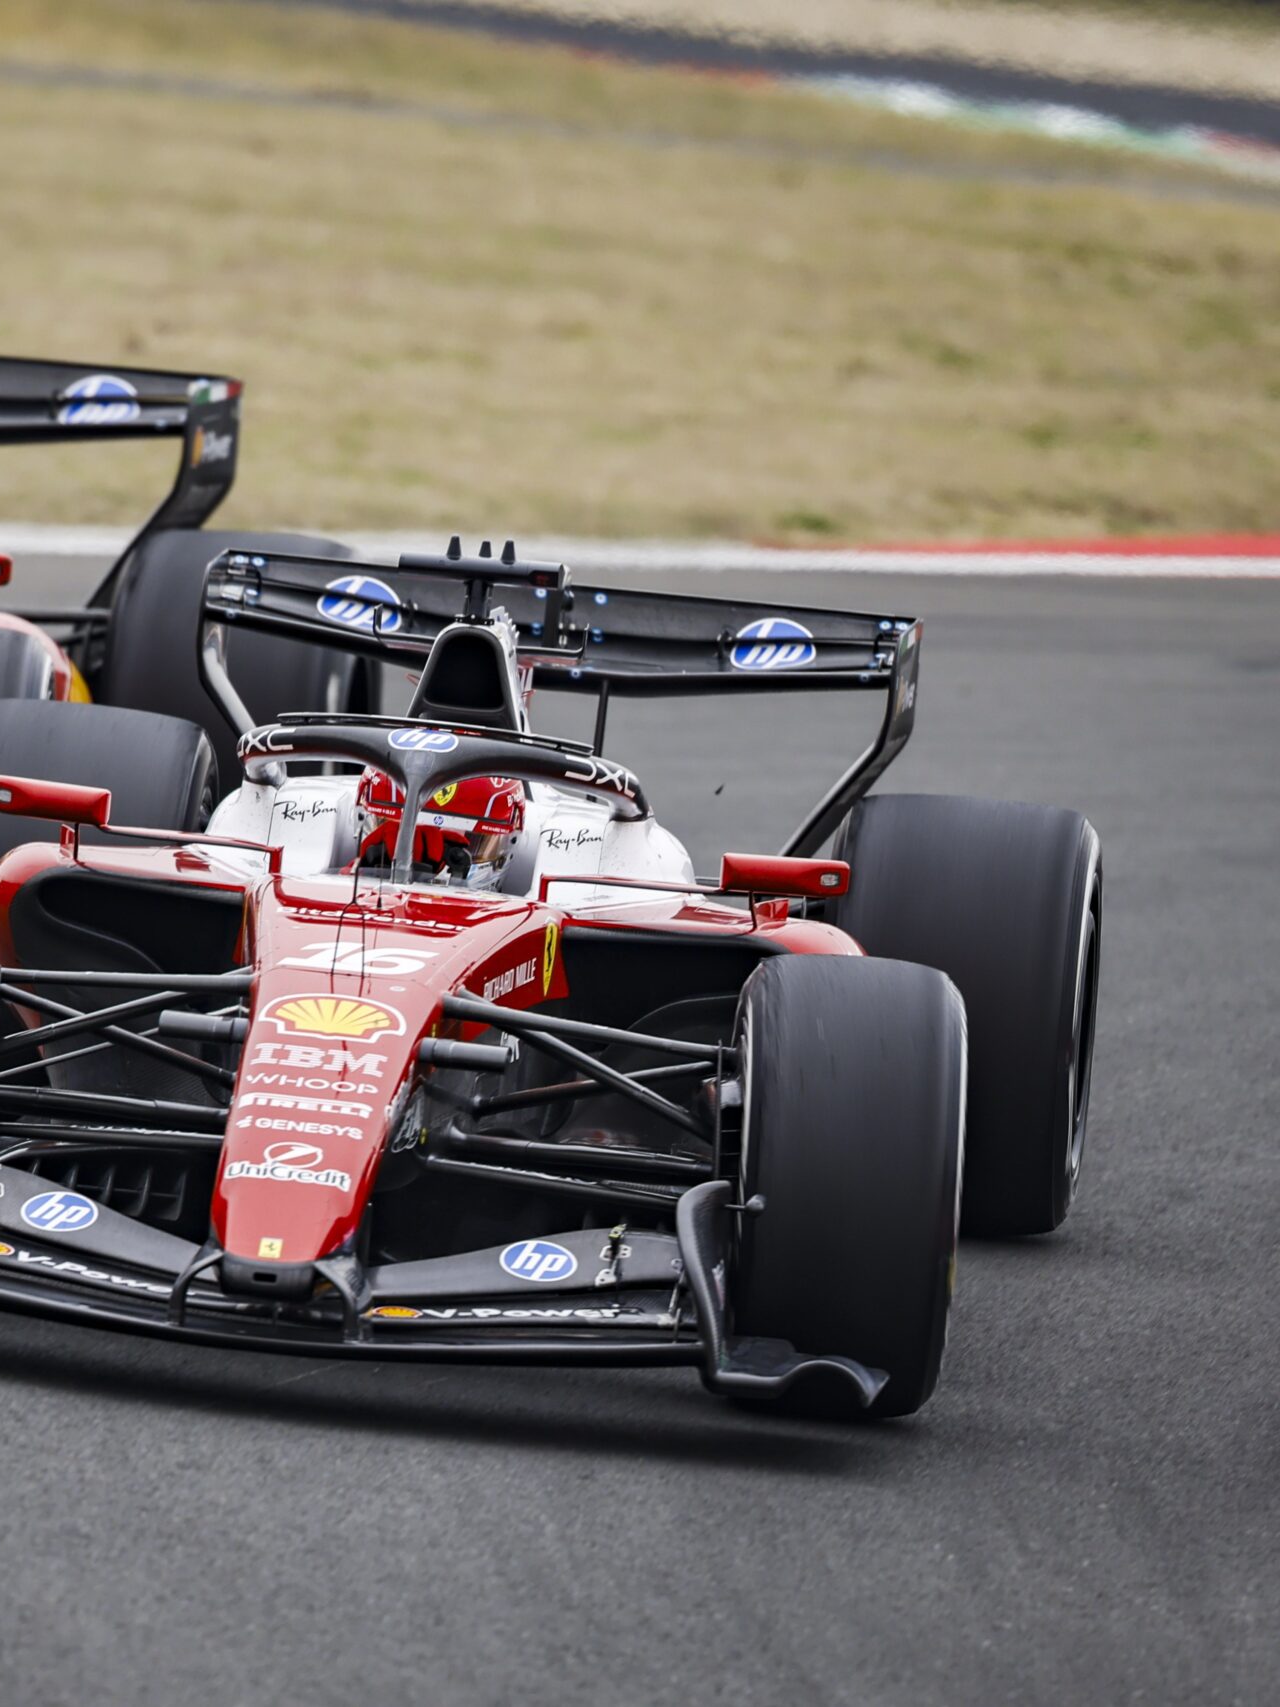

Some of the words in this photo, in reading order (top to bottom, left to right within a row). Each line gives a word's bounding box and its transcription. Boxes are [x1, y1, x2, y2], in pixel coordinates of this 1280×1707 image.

[273, 800, 337, 824] Ray-Ban
[540, 828, 603, 851] Ray-Ban
[276, 906, 468, 931] Bitdefender
[276, 941, 440, 975] 16
[483, 968, 515, 1002] RICHARD
[514, 957, 537, 989] MILLE
[250, 1042, 388, 1078] IBM
[246, 1072, 379, 1095] WHOOP
[238, 1092, 373, 1119] PIRELLI
[255, 1118, 363, 1140] GENESYS
[225, 1160, 352, 1193] UniCredit
[30, 1192, 91, 1231] hp
[17, 1251, 196, 1296] V-Powe
[510, 1241, 569, 1281] hp
[421, 1307, 622, 1320] V-Power
